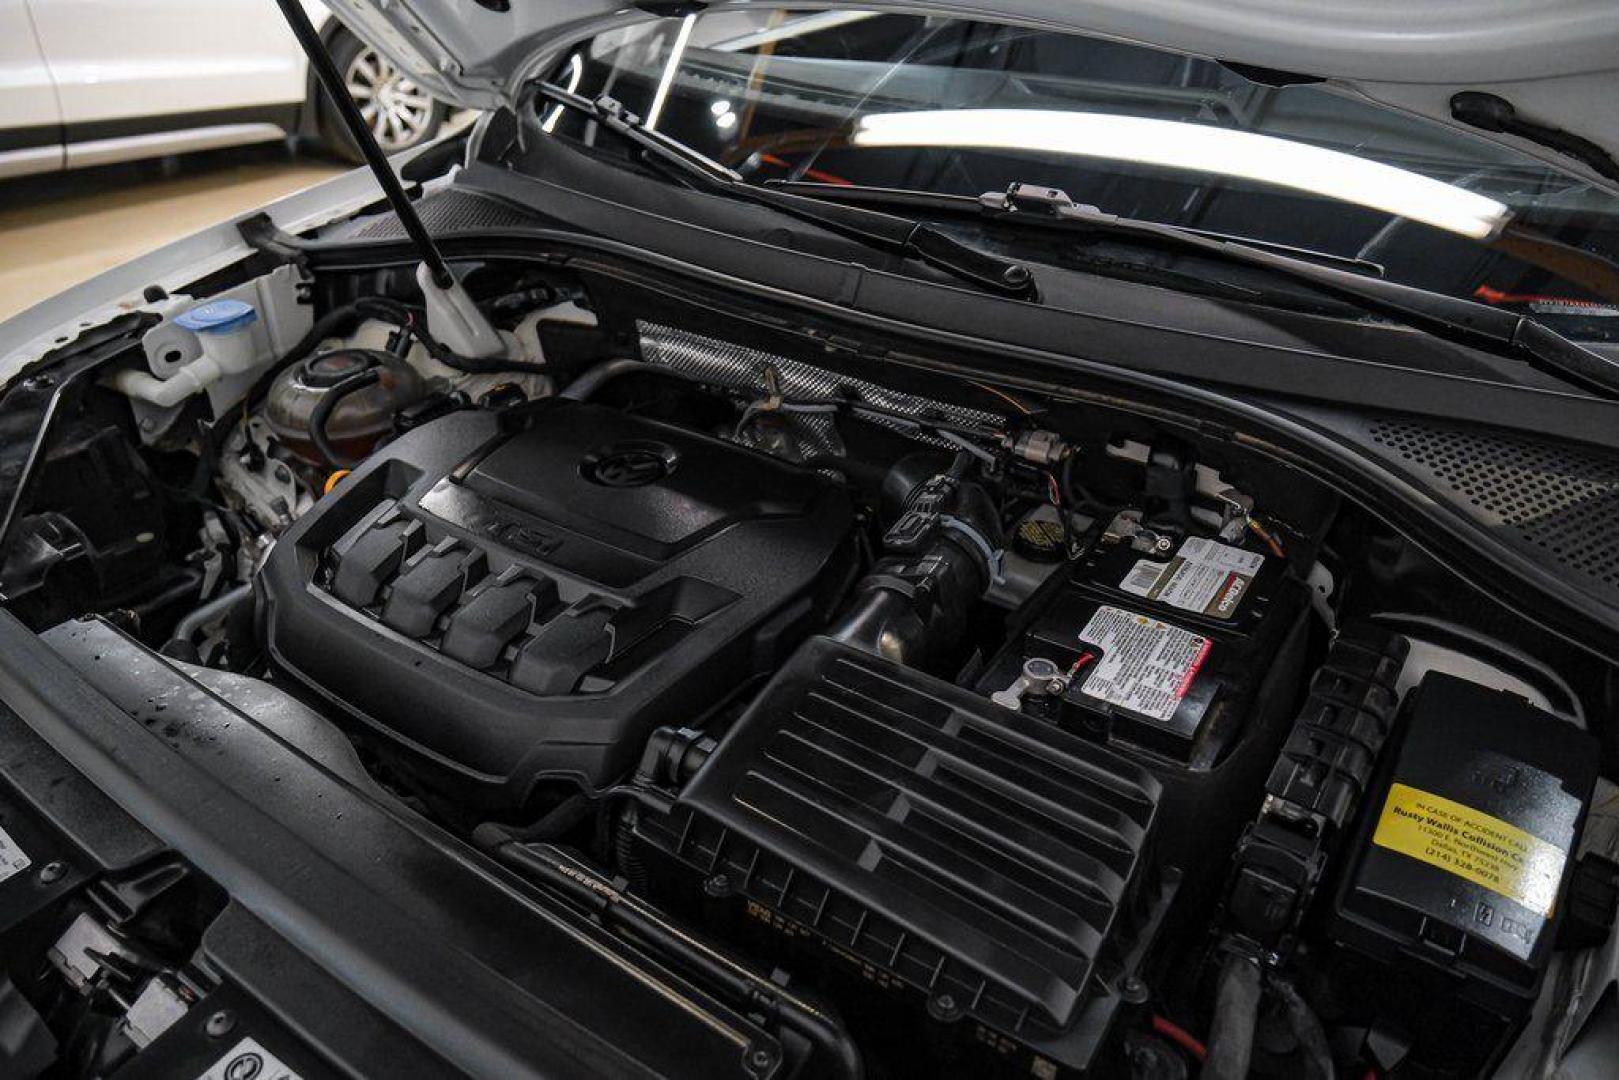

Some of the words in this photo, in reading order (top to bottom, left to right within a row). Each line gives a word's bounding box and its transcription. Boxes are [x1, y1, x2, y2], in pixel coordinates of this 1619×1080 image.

[1393, 806, 1425, 823] Rusty
[1426, 816, 1459, 836] Wallis
[1461, 831, 1510, 857] Collision
[1426, 805, 1448, 818] CASE
[1464, 820, 1507, 841] ACCIDENT
[1425, 847, 1451, 864] (214)
